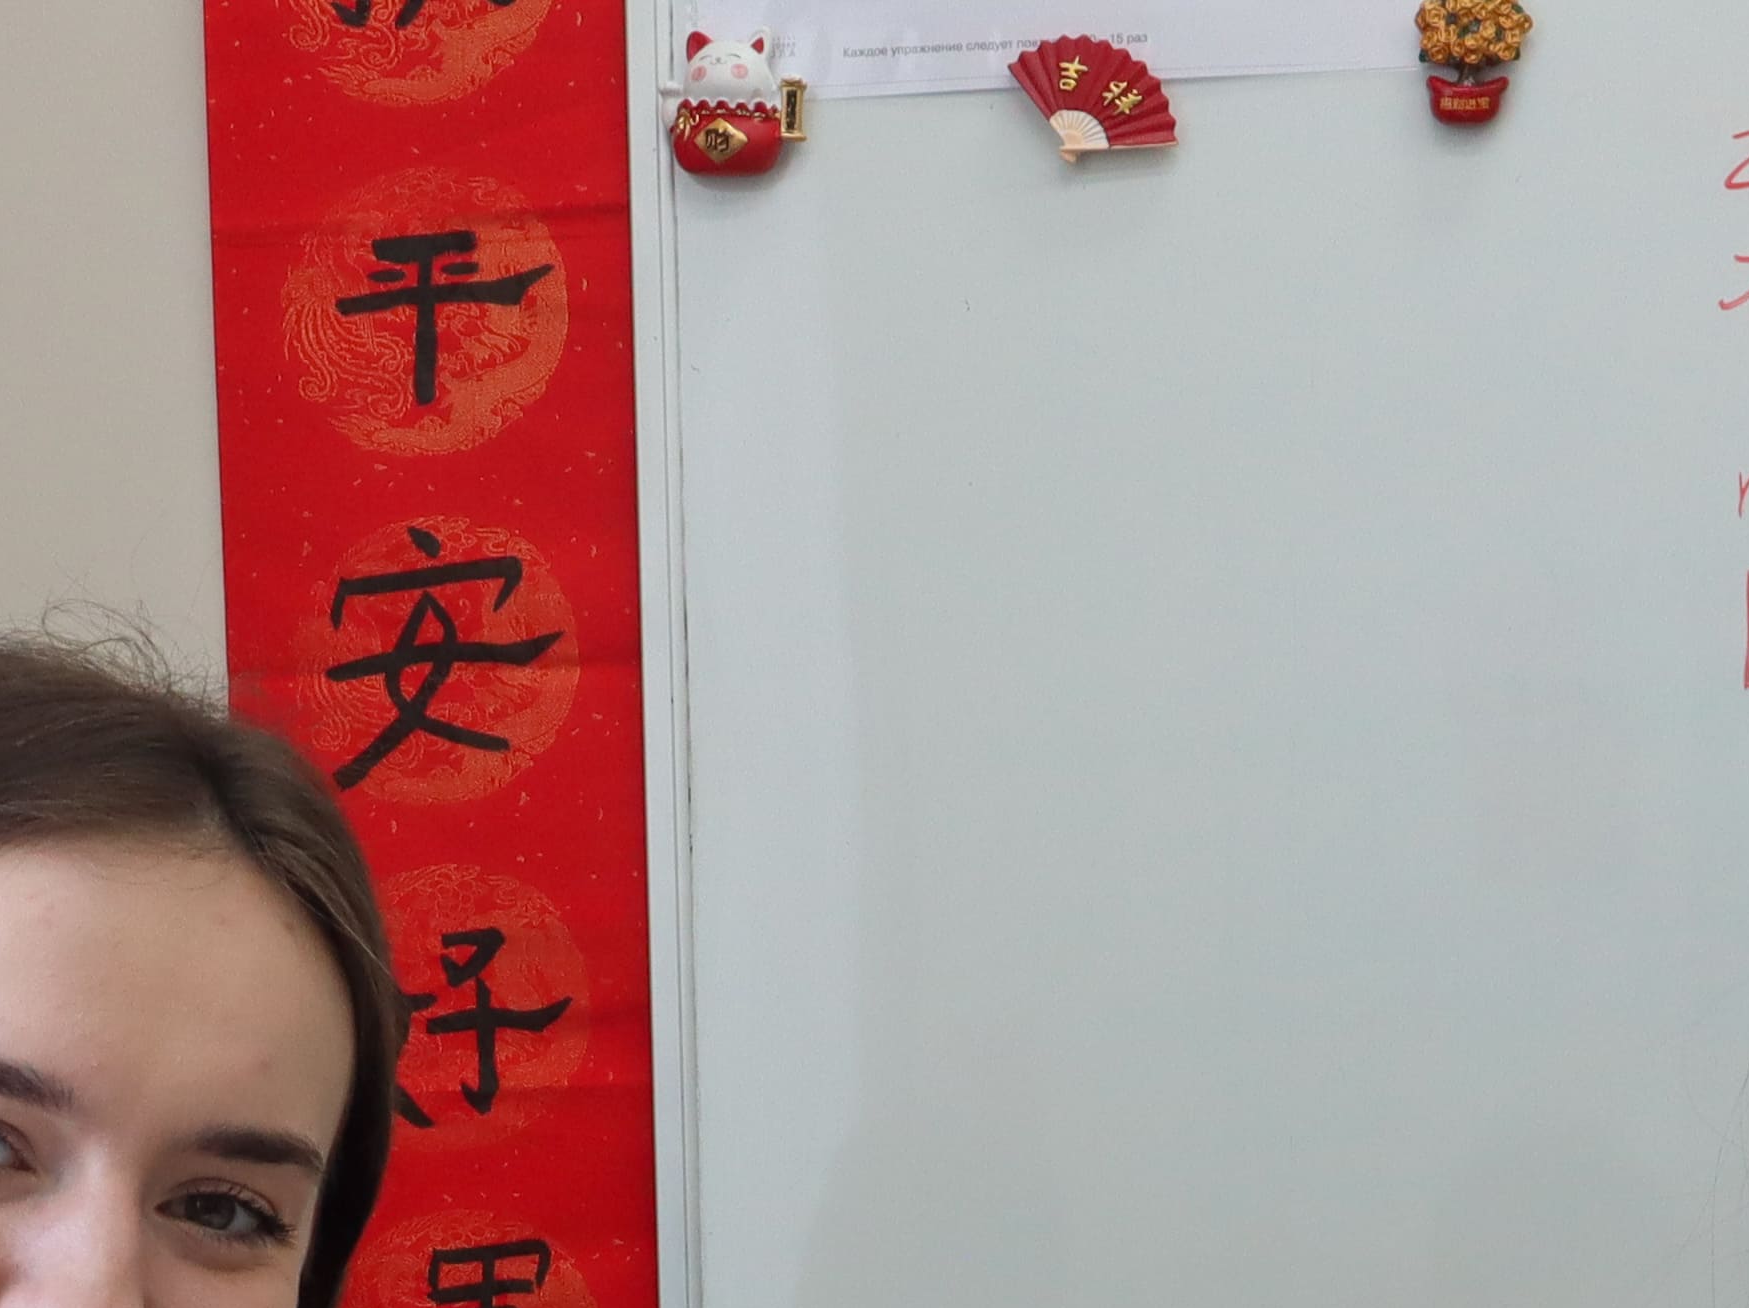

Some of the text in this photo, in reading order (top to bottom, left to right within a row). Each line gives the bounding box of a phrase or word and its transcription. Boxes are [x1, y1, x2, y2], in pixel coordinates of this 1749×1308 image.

[842, 46, 888, 59] Каждое
[891, 42, 964, 56] упражнение
[965, 40, 1013, 52] следует
[1126, 33, 1149, 47] раз
